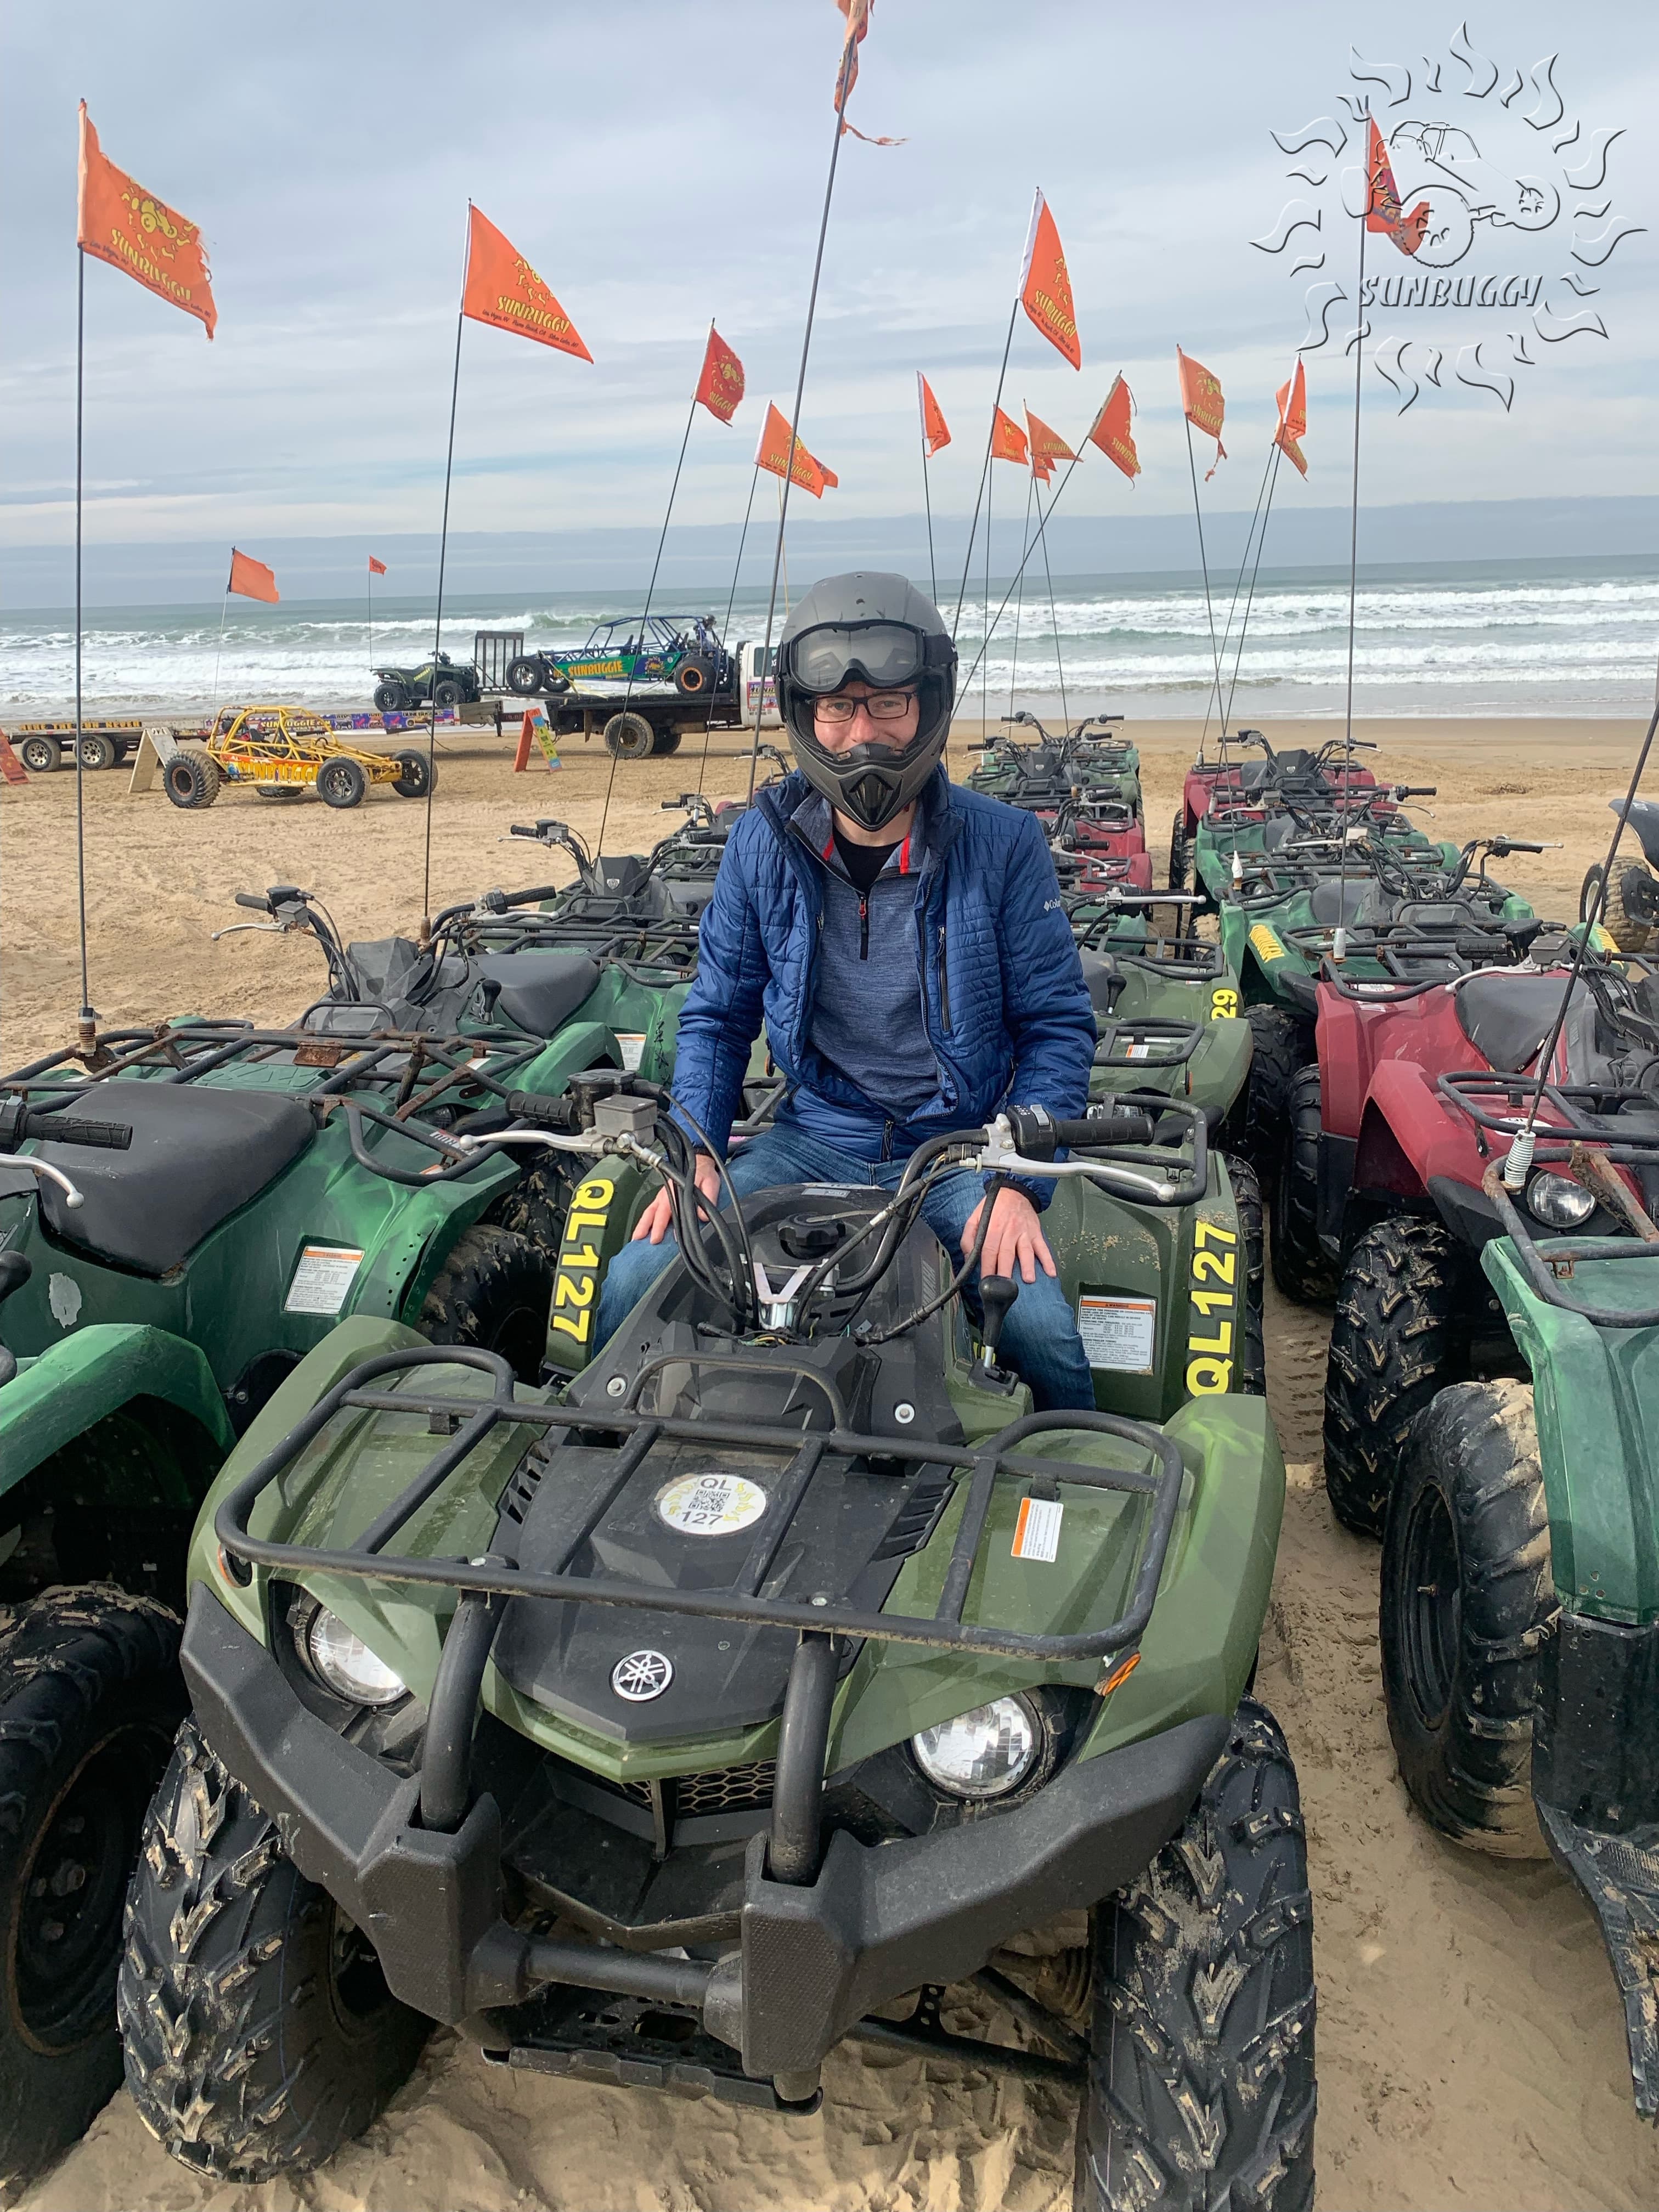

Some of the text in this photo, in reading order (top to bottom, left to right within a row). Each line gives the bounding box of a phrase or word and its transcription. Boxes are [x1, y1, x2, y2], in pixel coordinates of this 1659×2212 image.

[496, 295, 571, 334] SUNBUGGY
[770, 453, 813, 481] SUNUGGY
[568, 660, 623, 676] SUNBUGGIE
[551, 1178, 614, 1343] QL127
[1186, 1220, 1237, 1397] QL127
[701, 1477, 732, 1491] QL
[682, 1511, 724, 1525] 127
